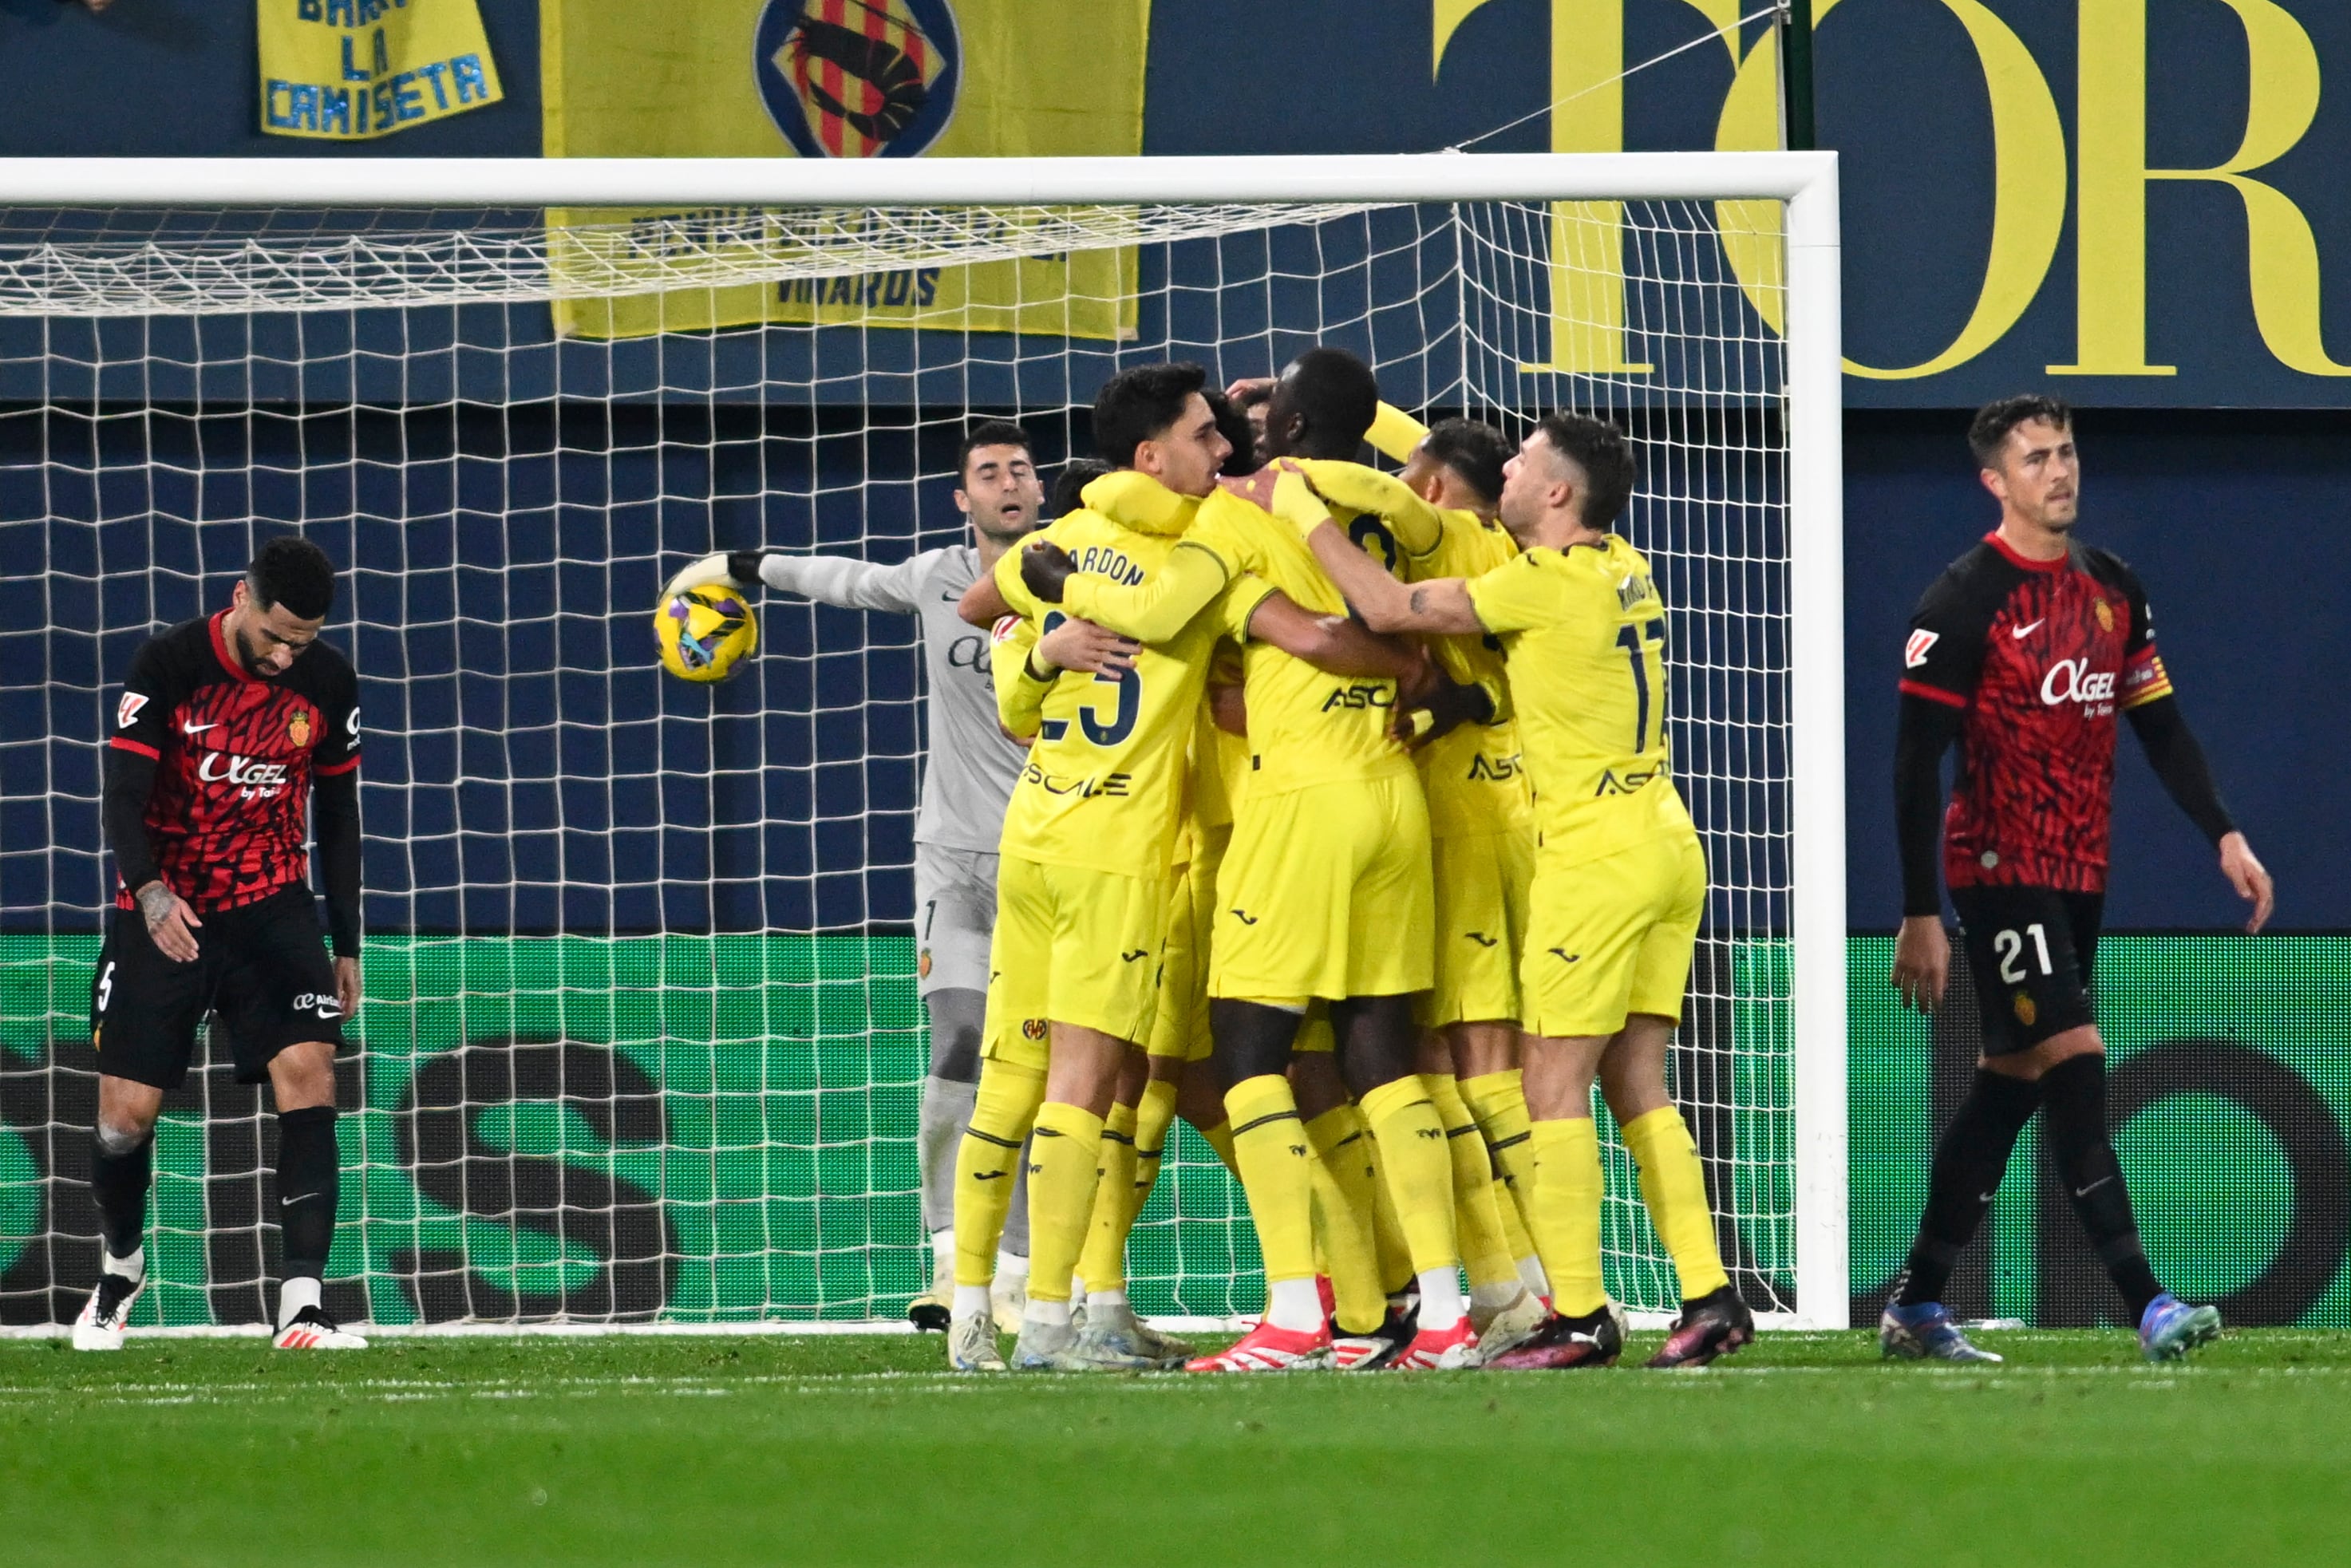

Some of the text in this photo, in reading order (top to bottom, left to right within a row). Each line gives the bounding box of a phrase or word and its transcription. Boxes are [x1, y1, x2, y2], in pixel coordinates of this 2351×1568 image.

[267, 53, 488, 134] CAMISETA
[1430, 0, 2351, 380] TOR
[1068, 547, 1144, 586] ARDON
[241, 786, 255, 800] by
[1024, 763, 1132, 799] SCALE
[924, 899, 937, 941] 1
[1994, 923, 2053, 985] 21
[98, 961, 116, 1012] 5
